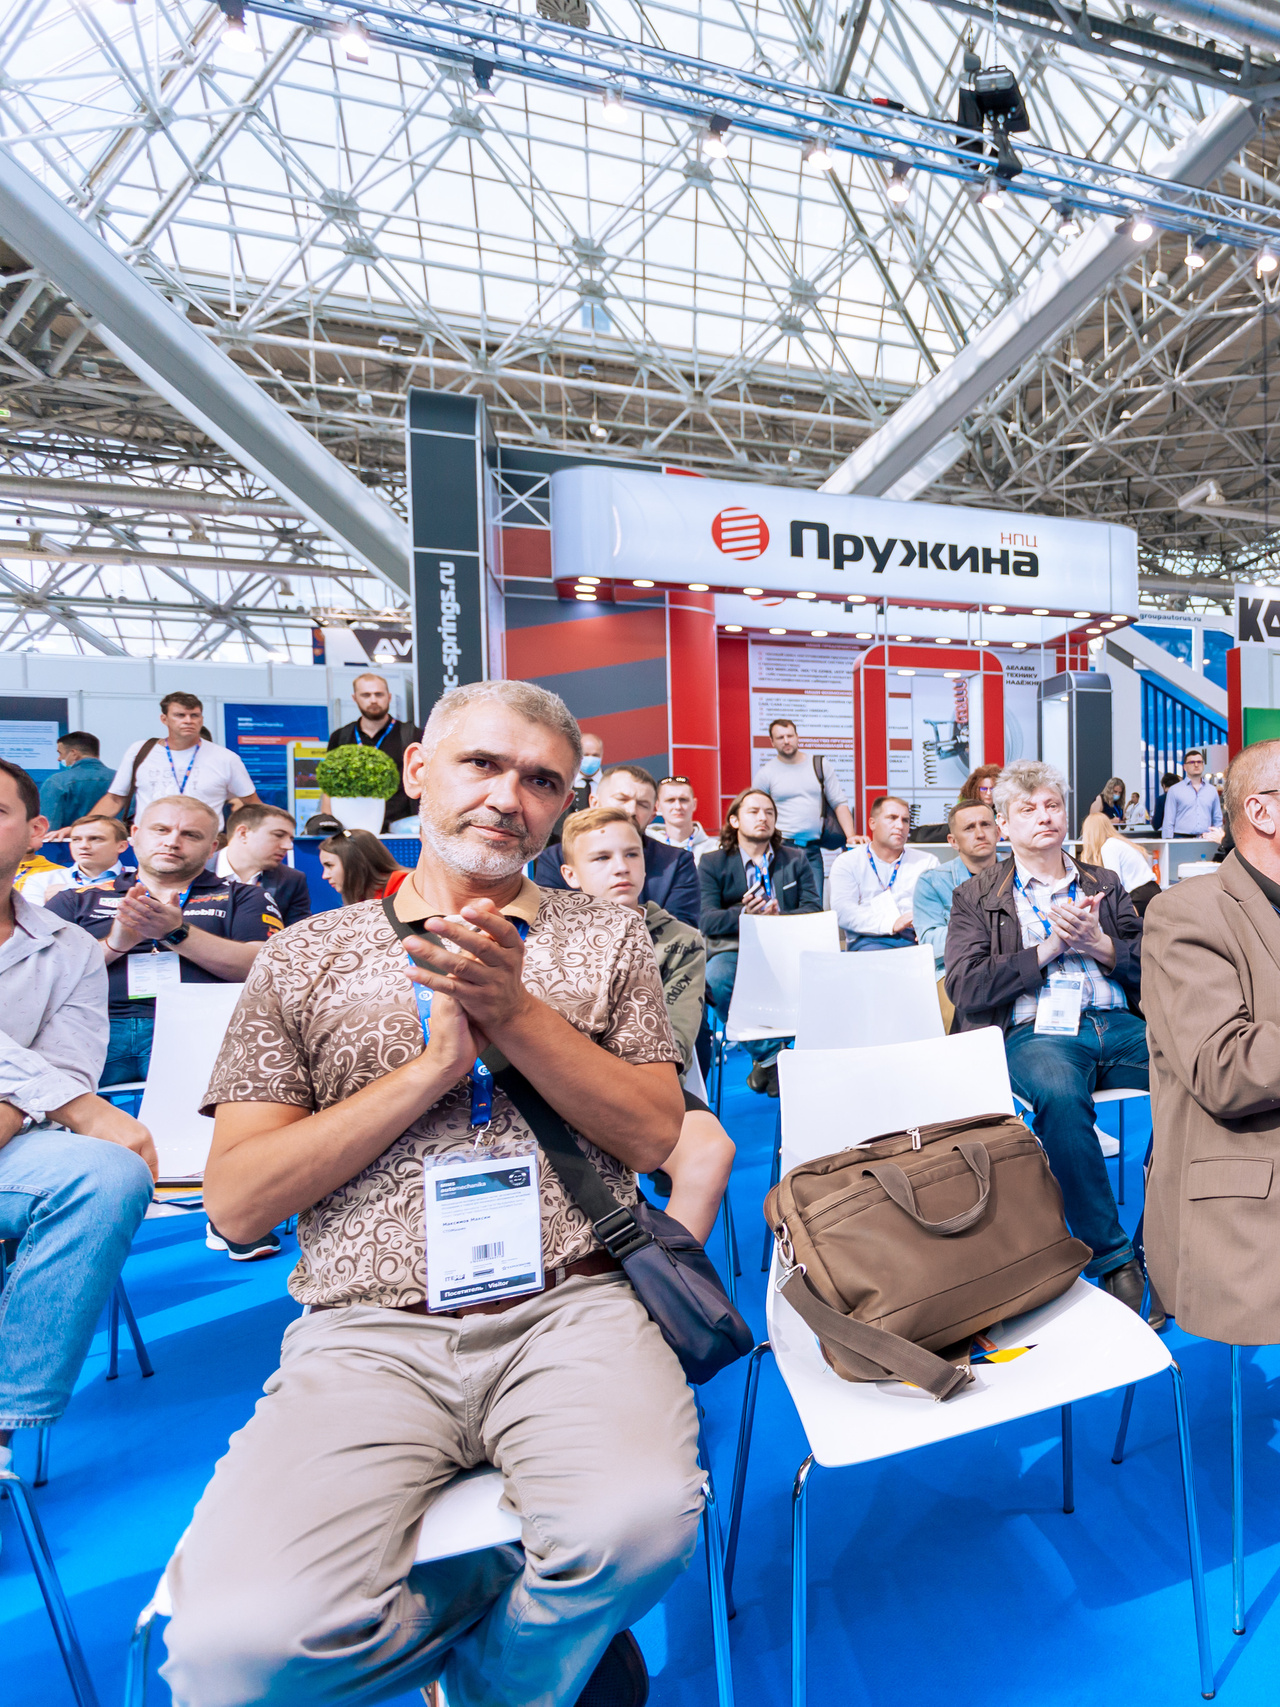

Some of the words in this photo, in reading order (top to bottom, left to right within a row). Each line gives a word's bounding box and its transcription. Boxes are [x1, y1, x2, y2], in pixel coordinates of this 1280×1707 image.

[790, 520, 1039, 577] Пружина
[1000, 532, 1038, 548] НПЦ
[1139, 613, 1202, 622] groupautorus.ru
[666, 974, 692, 1006] Kappa
[444, 1286, 484, 1298] Посетитель
[487, 1280, 509, 1289] Visitor
